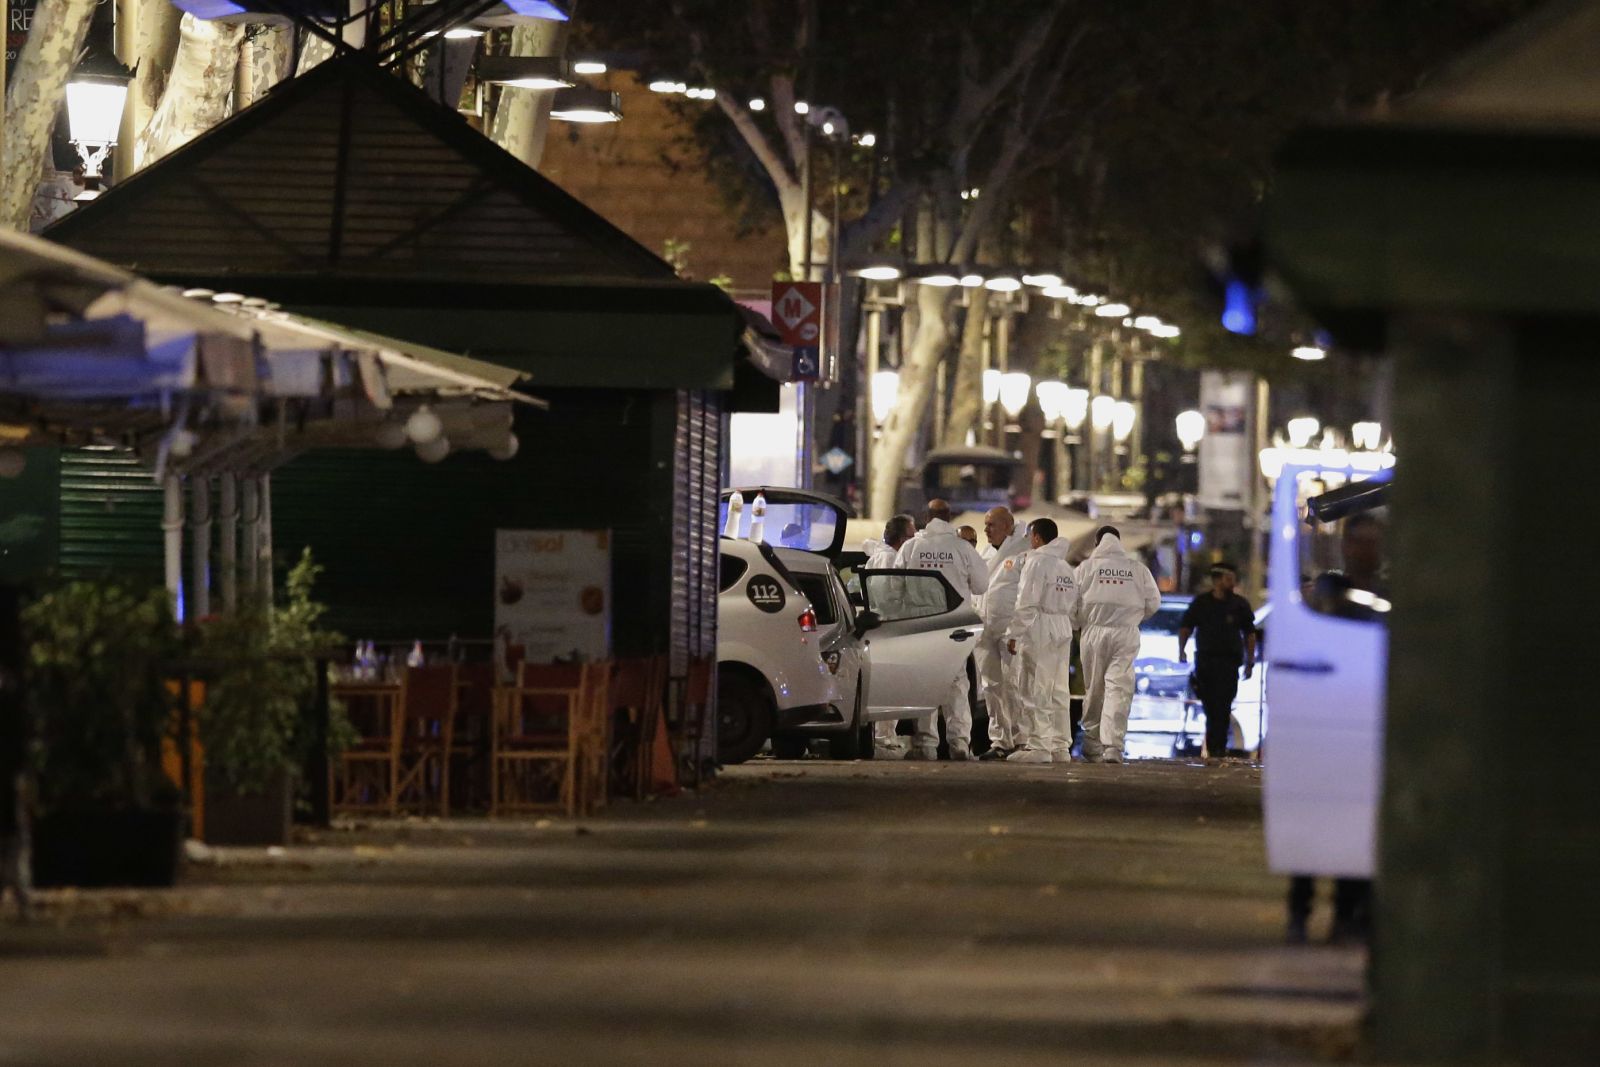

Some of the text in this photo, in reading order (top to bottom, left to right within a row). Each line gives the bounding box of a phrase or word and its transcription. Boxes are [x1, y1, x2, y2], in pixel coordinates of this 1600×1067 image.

[784, 298, 802, 318] M
[920, 552, 954, 560] POLICIA
[1099, 568, 1134, 577] POLICIA
[752, 584, 780, 600] 112
